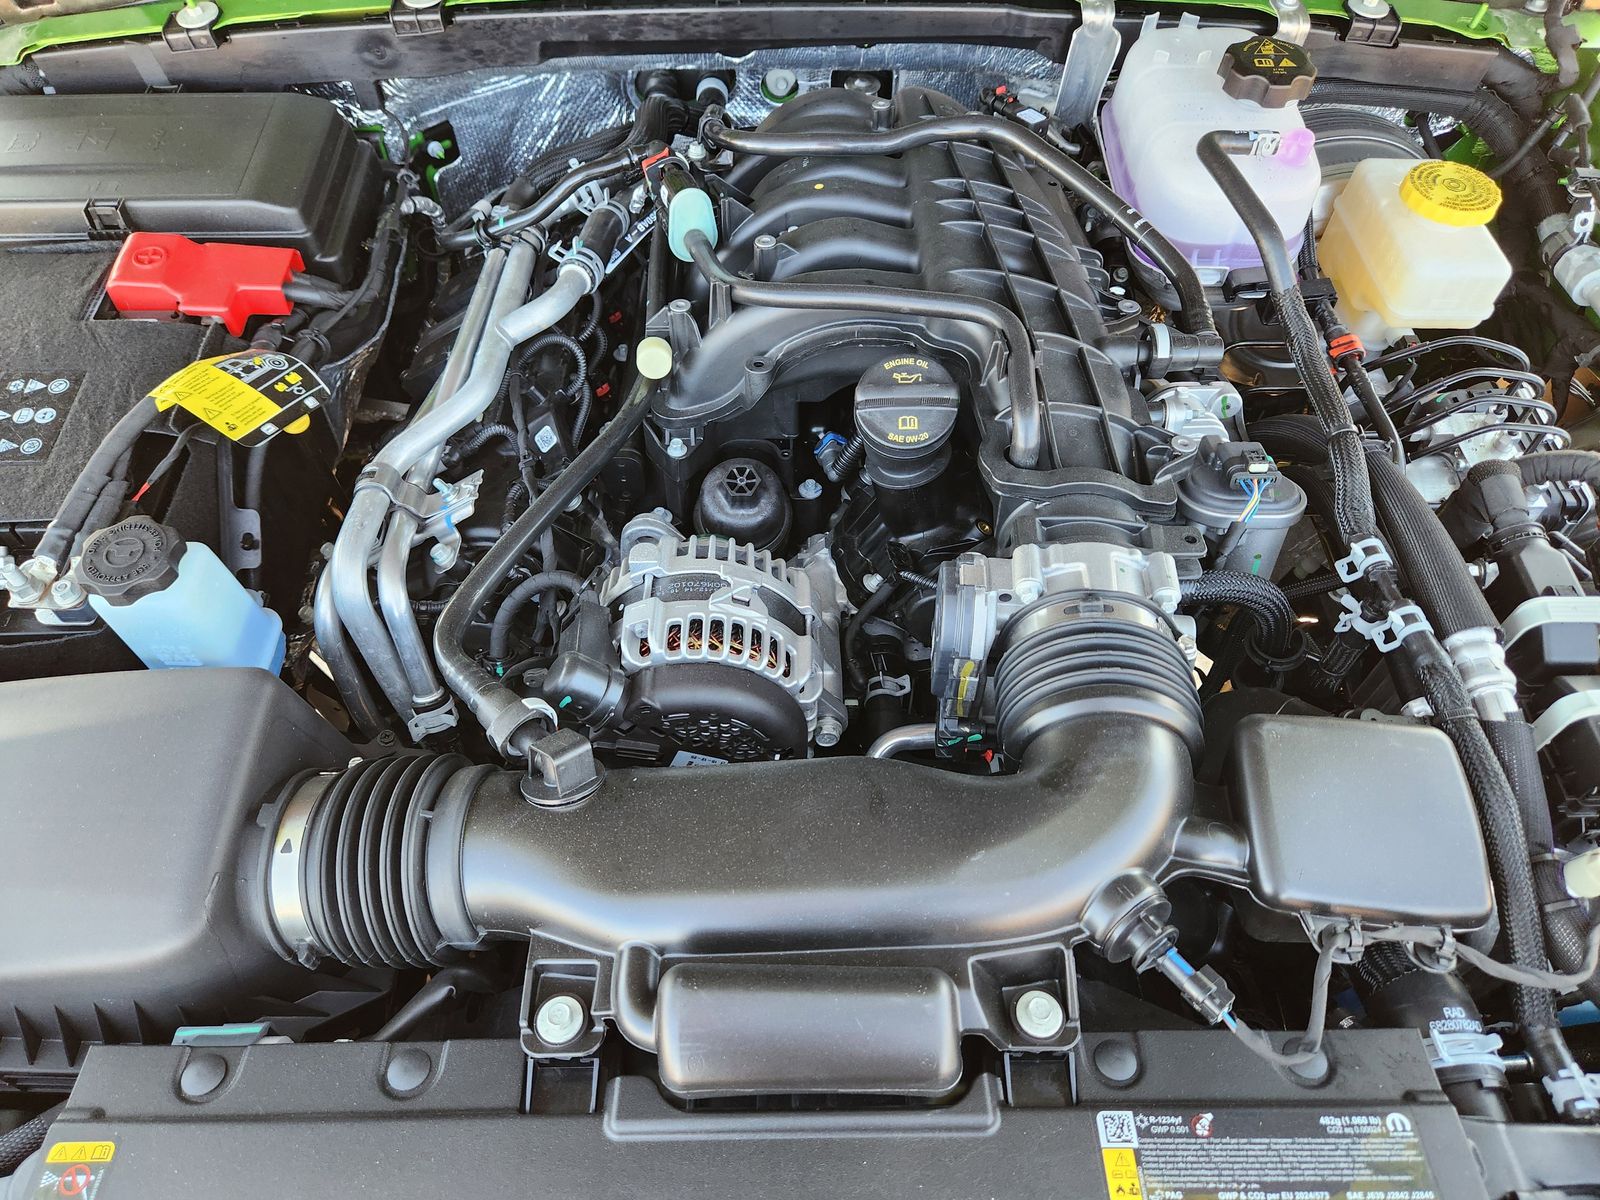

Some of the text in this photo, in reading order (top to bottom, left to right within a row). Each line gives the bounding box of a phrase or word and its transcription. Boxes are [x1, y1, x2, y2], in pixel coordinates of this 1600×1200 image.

[884, 358, 929, 370] ENGINE OIL
[887, 432, 929, 443] SAE 0W-20
[1443, 1006, 1466, 1019] RAD
[1165, 1191, 1183, 1200] PAG
